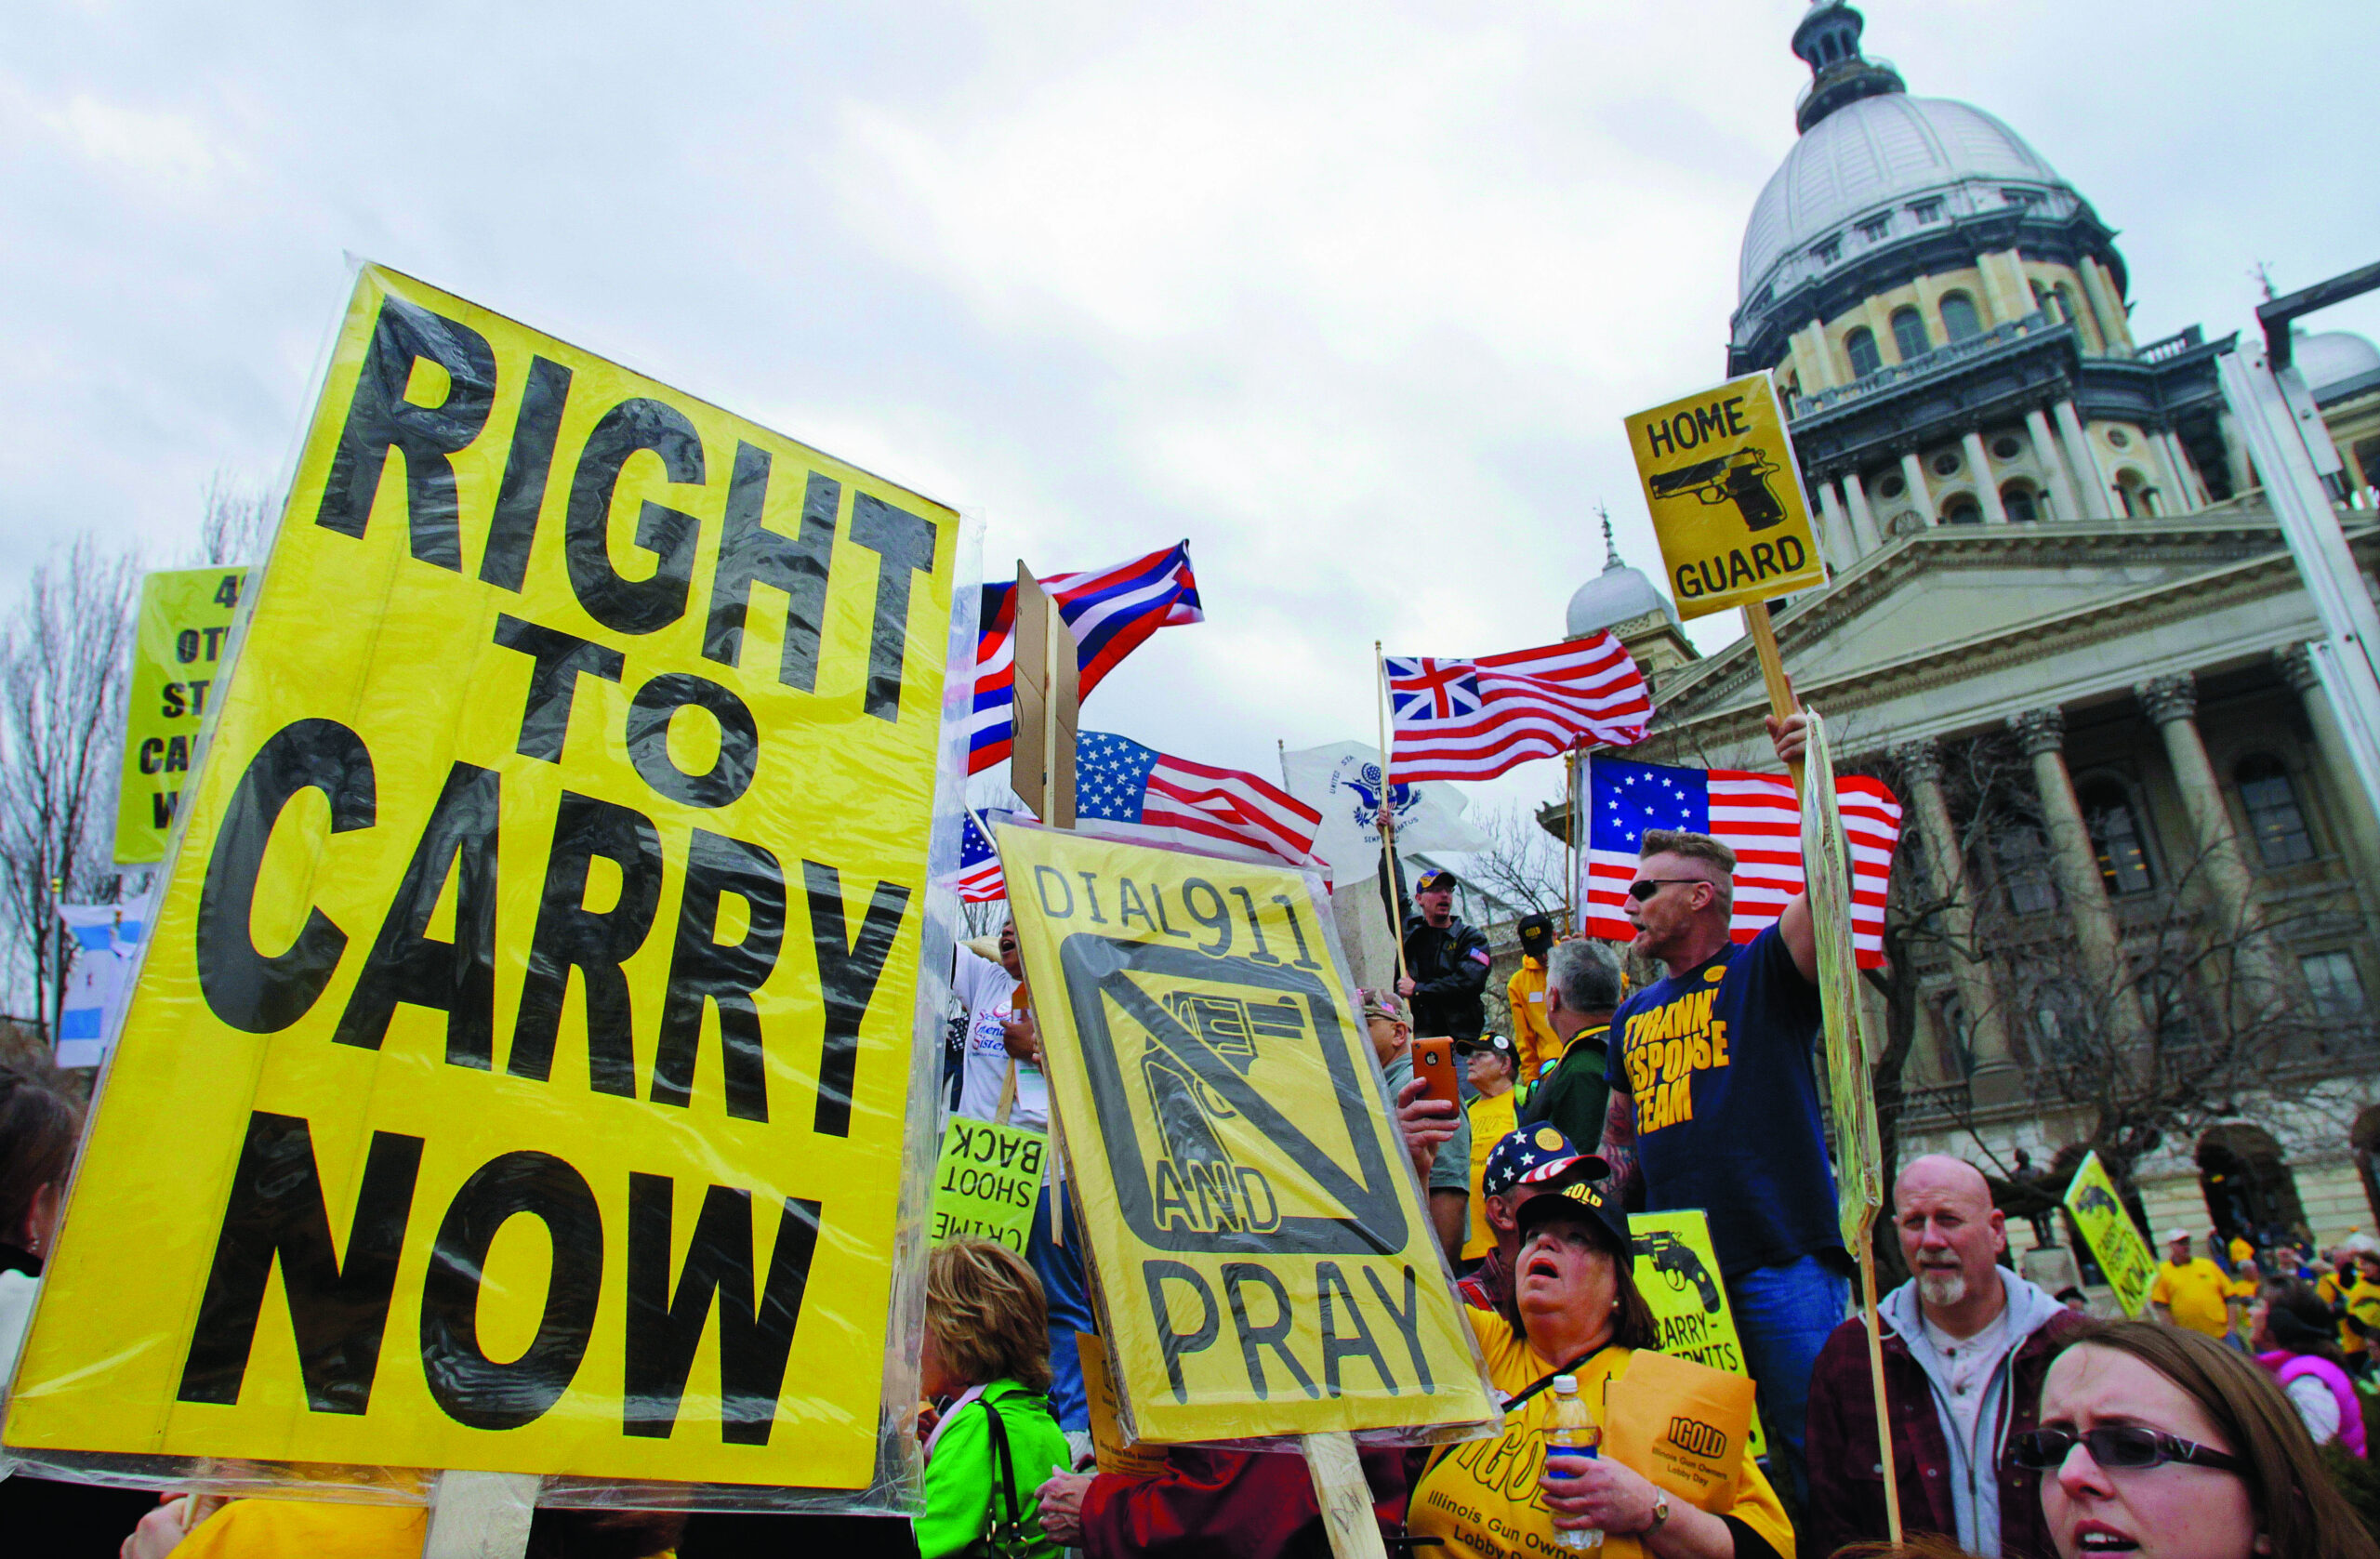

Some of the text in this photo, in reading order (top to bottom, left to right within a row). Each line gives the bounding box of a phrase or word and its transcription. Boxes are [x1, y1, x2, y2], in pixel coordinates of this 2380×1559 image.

[1646, 396, 1751, 457] HOME
[315, 294, 937, 725] RIGHT
[214, 575, 246, 609] 4
[1675, 535, 1805, 598] GUARD
[492, 613, 760, 809] TO
[1364, 836, 1381, 844] SEMP
[1395, 816, 1419, 835] ARATUS
[196, 718, 912, 1139] CARRY
[1035, 865, 1322, 972] DIAL 911
[1634, 1073, 1693, 1136] TEAM
[950, 1124, 1042, 1174] BACK
[941, 1166, 1033, 1208] SHOOT
[1154, 1157, 1281, 1235] AND
[177, 1111, 822, 1447] NOW
[1143, 1260, 1435, 1403] PRAY
[1668, 1416, 1726, 1459] IGOLD
[1679, 1457, 1697, 1470] Gun
[1699, 1463, 1727, 1480] Owners
[1667, 1464, 1709, 1486] Lobby Day
[1428, 1489, 1483, 1524] Illinois
[1488, 1518, 1520, 1542] Gun
